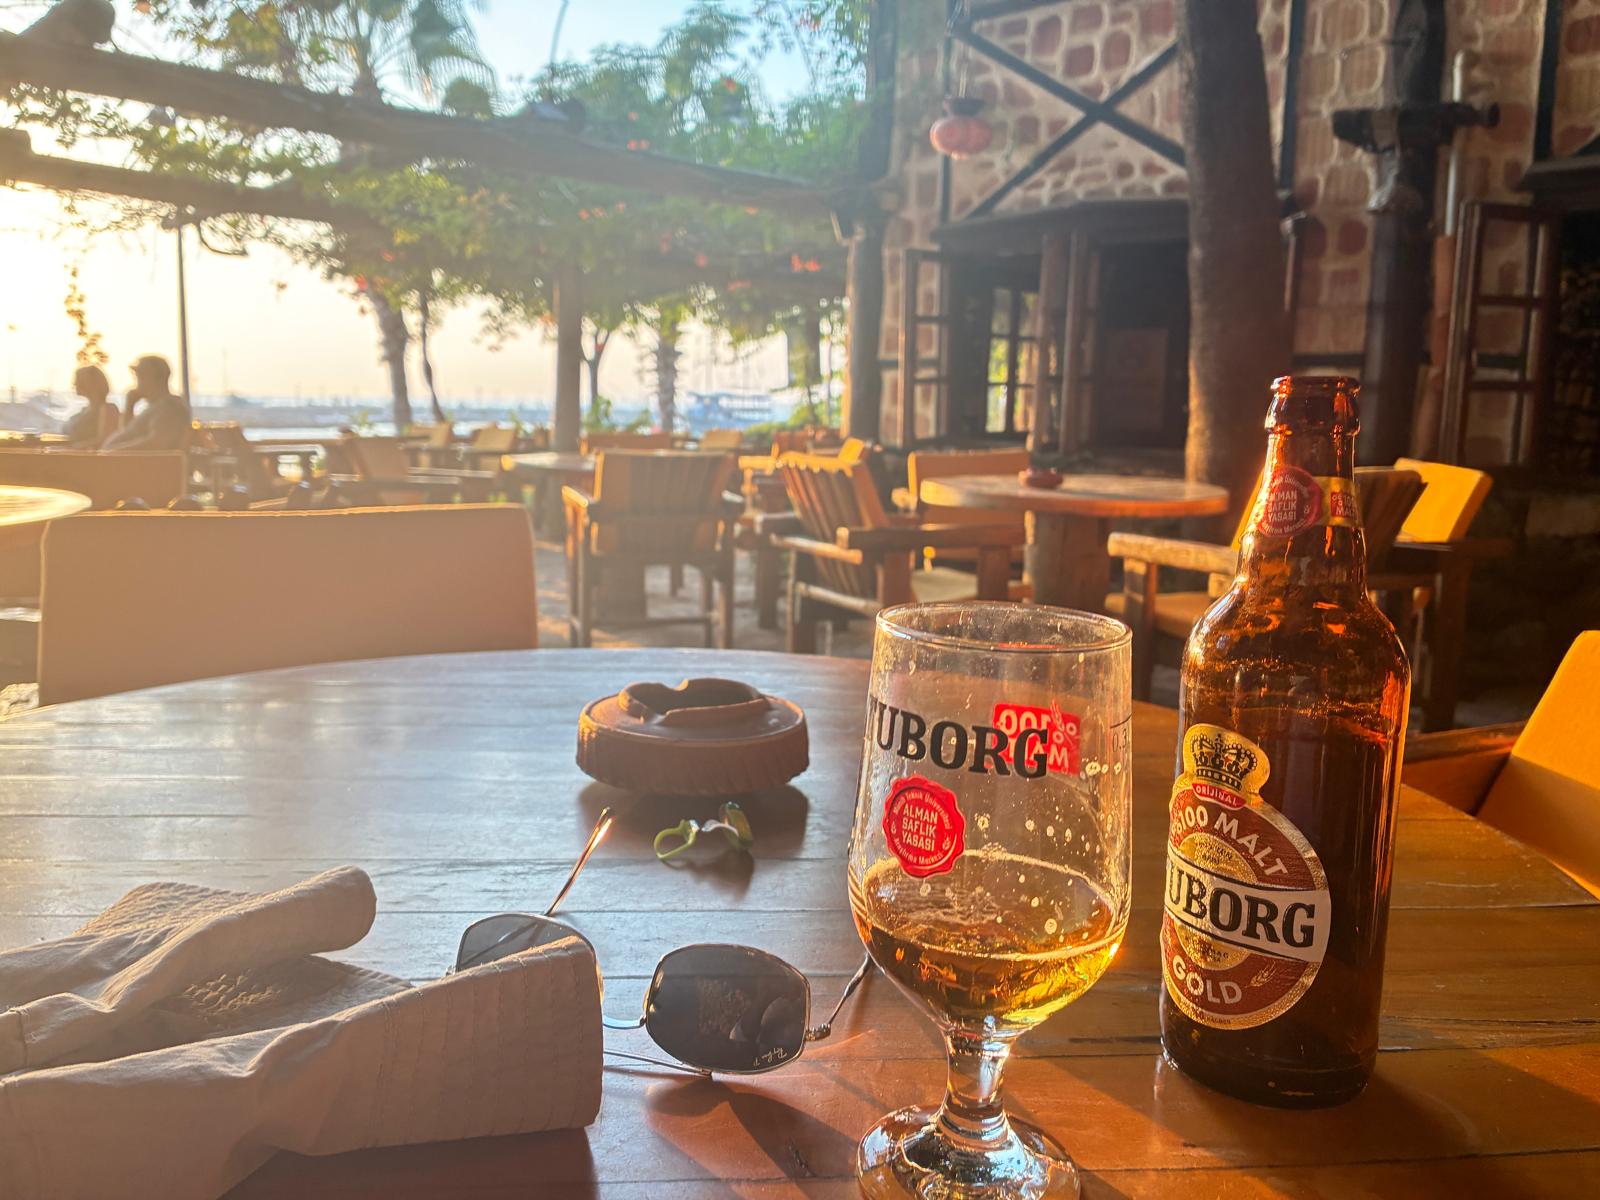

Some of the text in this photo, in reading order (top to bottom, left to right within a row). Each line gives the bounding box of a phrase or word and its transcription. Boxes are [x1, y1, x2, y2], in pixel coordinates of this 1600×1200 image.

[903, 803, 938, 825] ALMAN
[902, 817, 937, 838] SAFLIK
[902, 830, 935, 852] YASASI
[1214, 812, 1288, 877] MALT
[1173, 954, 1242, 1004] GOLD
